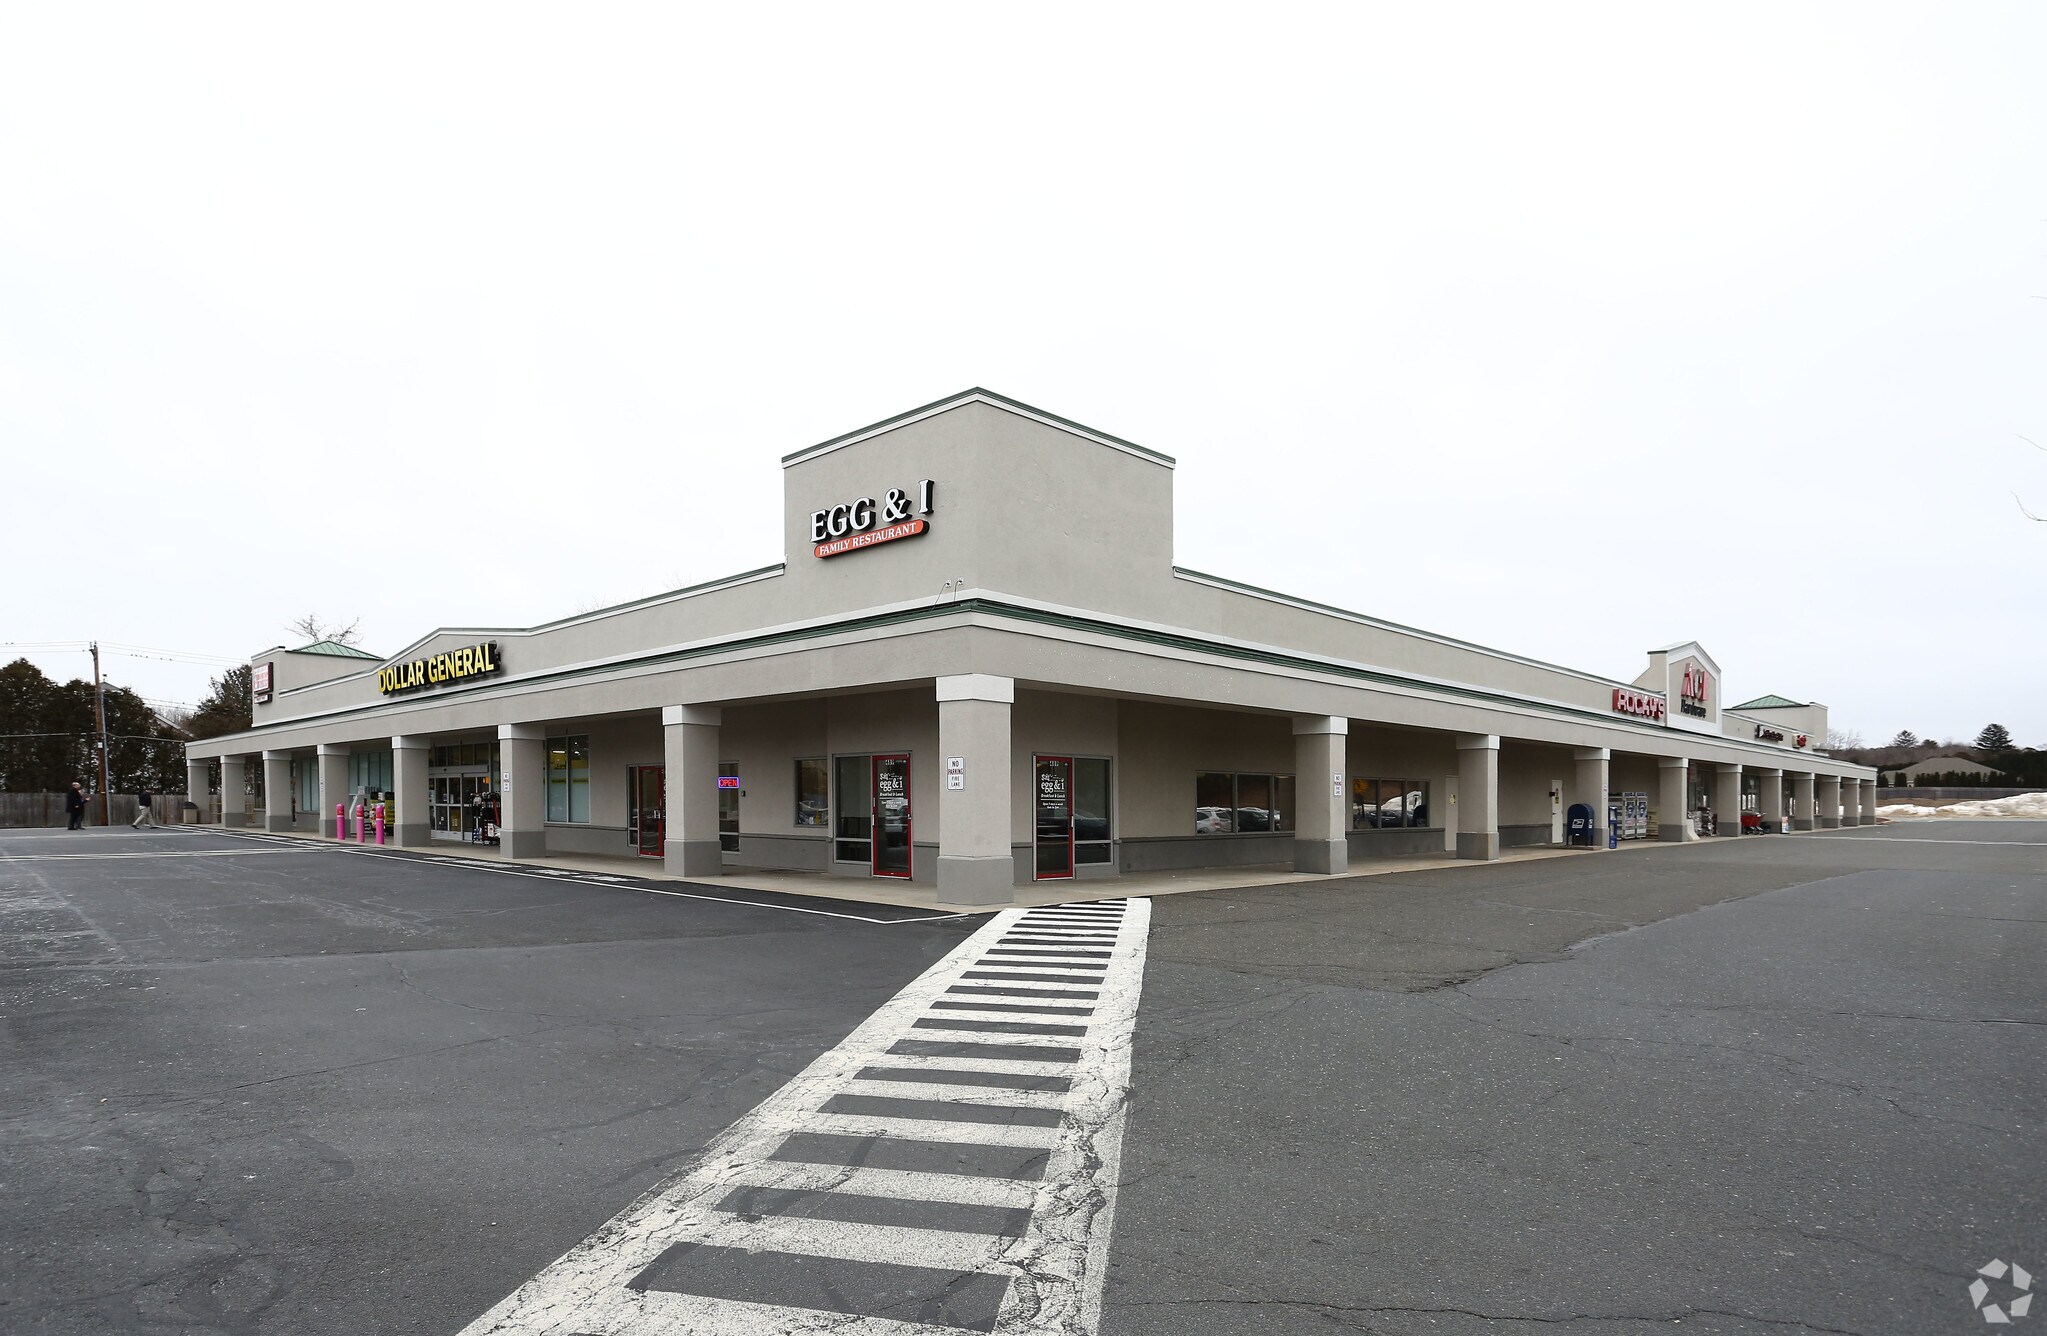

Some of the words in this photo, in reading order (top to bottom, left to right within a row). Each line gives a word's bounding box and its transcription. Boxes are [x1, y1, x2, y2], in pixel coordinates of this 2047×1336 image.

[810, 497, 876, 542] EGG
[881, 488, 912, 523] &
[918, 479, 934, 515] I
[819, 539, 851, 556] FAMILY
[852, 522, 917, 547] RESTAURANT
[378, 659, 425, 693] DOLLAR
[427, 643, 495, 683] GENERAL
[719, 778, 738, 787] OPEN
[880, 780, 892, 792] egg
[892, 777, 899, 788] &
[1040, 781, 1054, 793] egg
[1054, 780, 1061, 790] &
